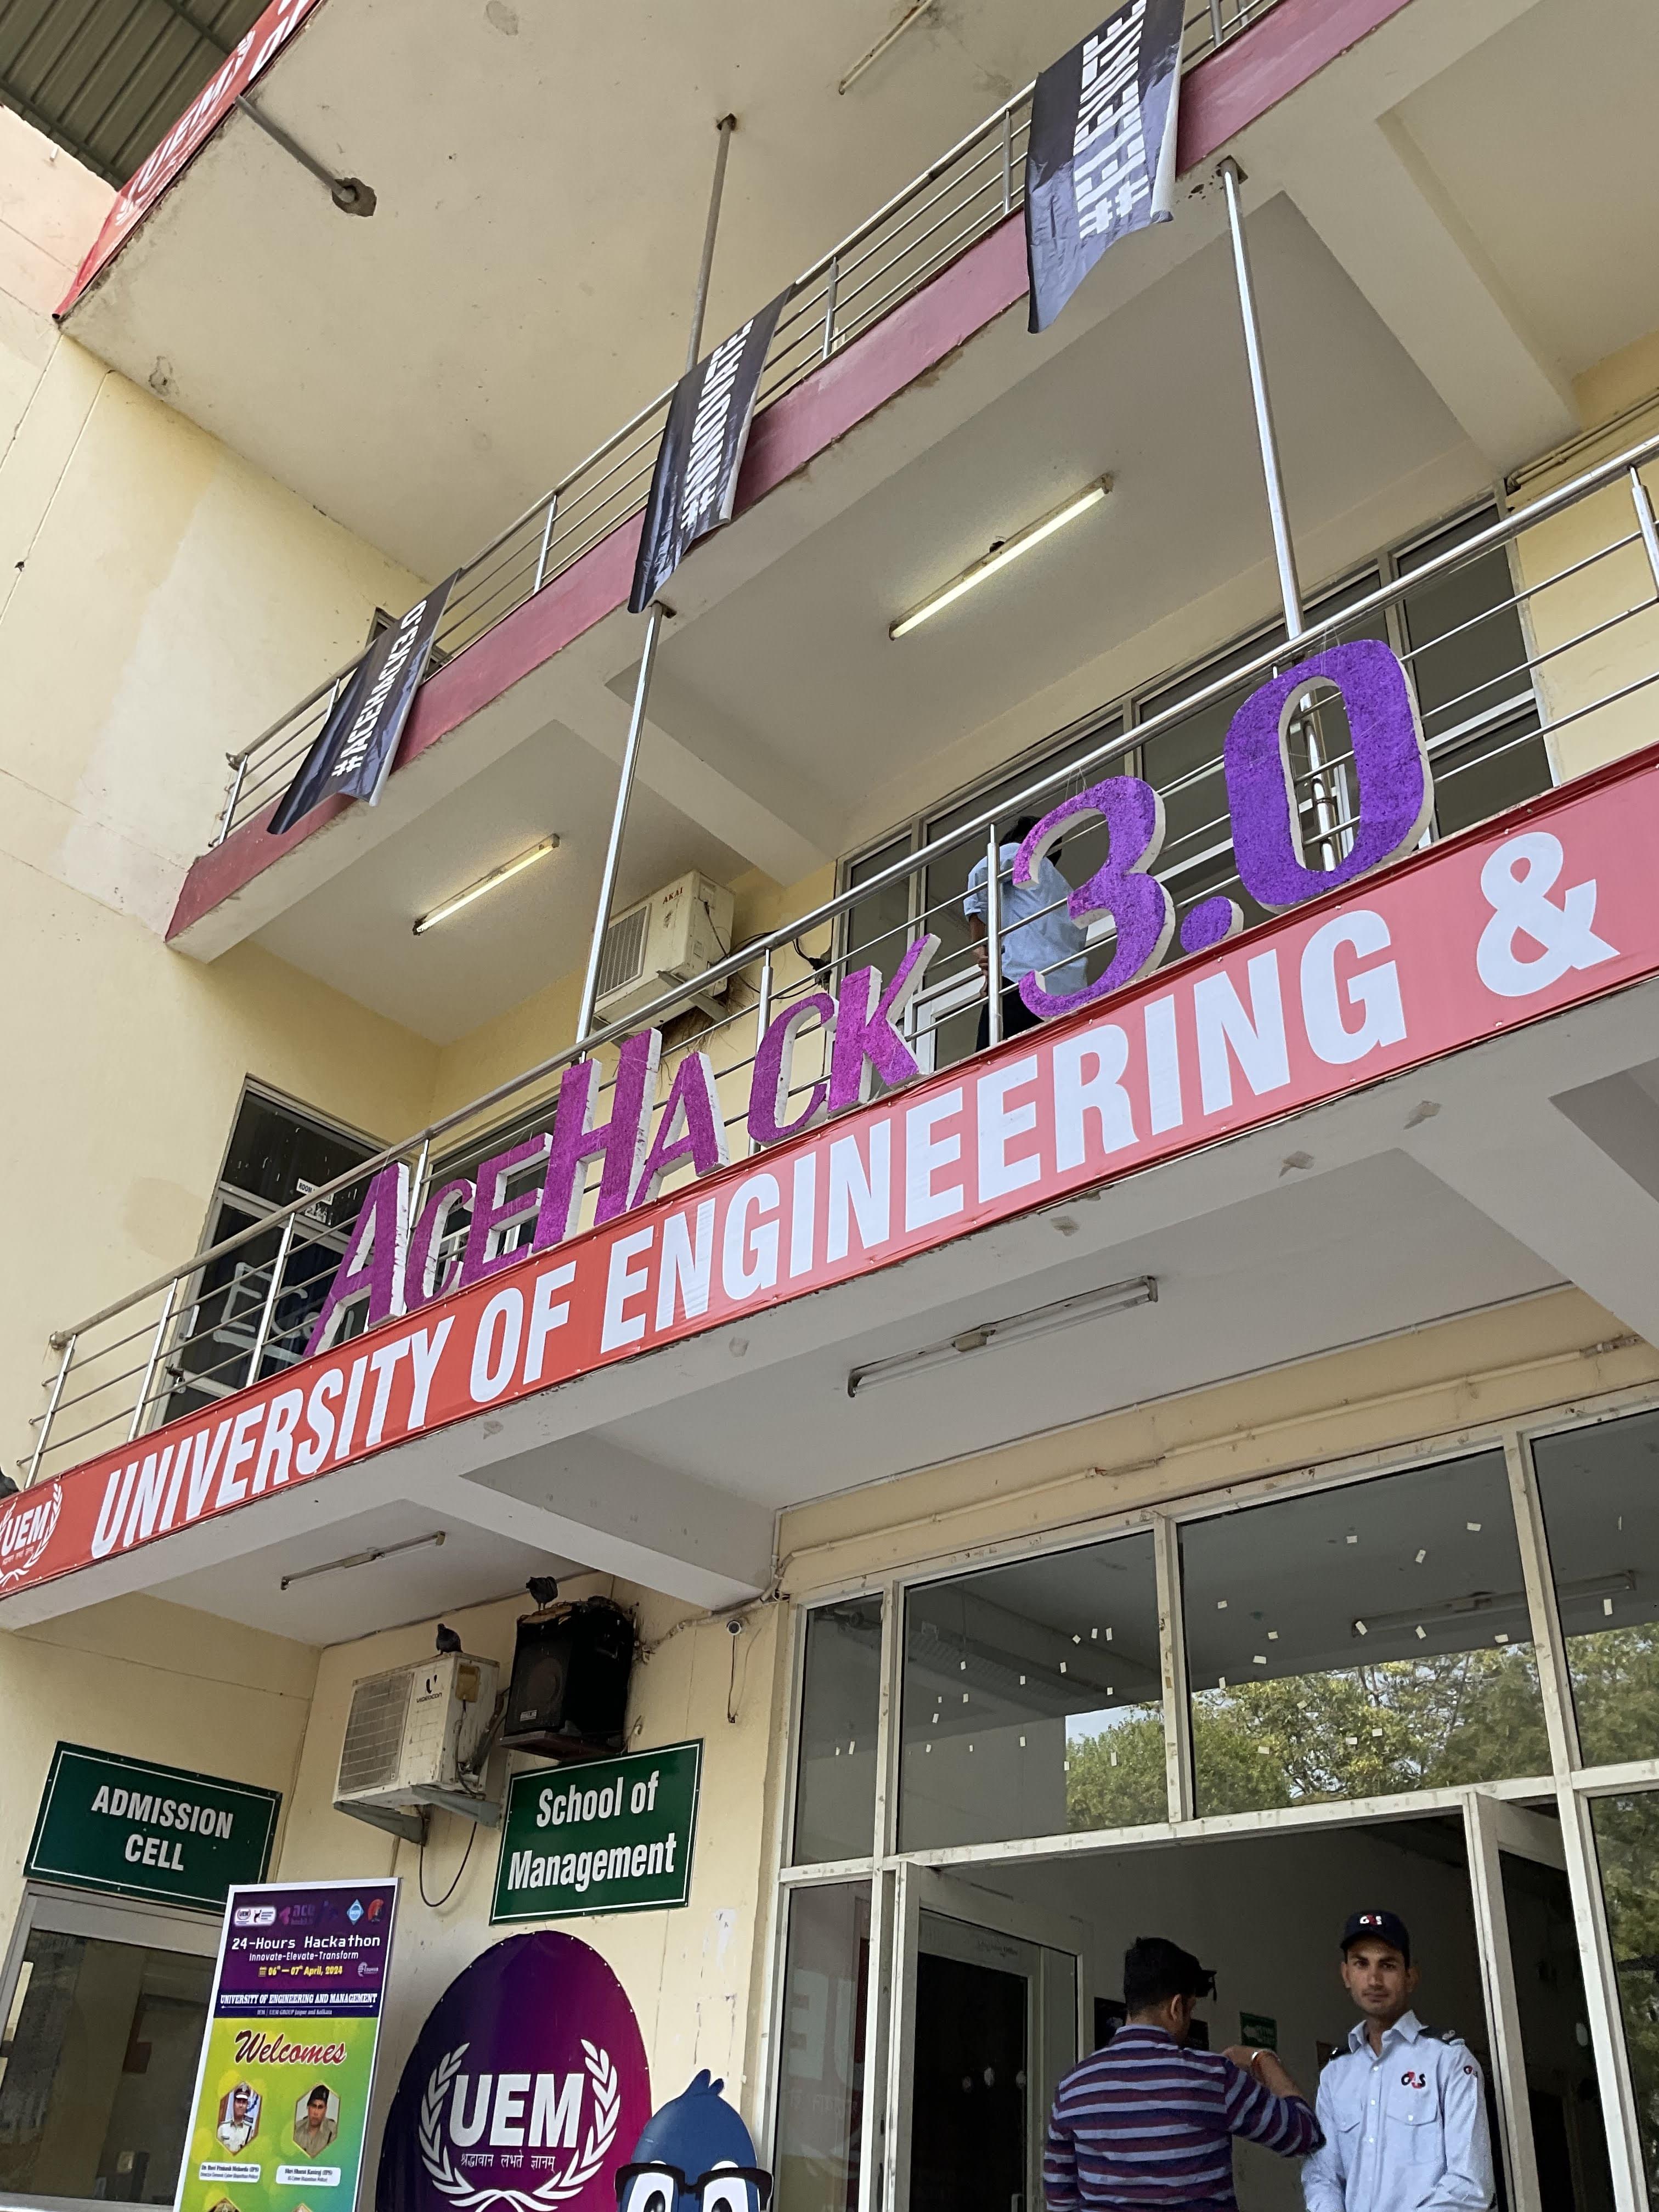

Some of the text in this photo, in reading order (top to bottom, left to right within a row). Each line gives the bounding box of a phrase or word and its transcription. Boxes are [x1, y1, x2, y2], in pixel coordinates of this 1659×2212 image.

[1073, 0, 1149, 240] #ELEVATE
[680, 319, 754, 529] #INNOVATE
[331, 600, 427, 777] #ACEHACK3.0
[1012, 639, 1434, 1019] 3.0
[663, 887, 684, 904] AKAI
[91, 831, 1621, 1559] UNIVERSITY OF ENGINEERING &
[298, 1182, 313, 1193] ROOM
[2, 1500, 53, 1556] UEM
[91, 1785, 234, 1839] ADMISSION
[537, 1770, 659, 1827] School of
[125, 1834, 184, 1871] CELL
[507, 1832, 676, 1893] Management
[232, 1934, 380, 1950] 24-Hours Hackathon
[250, 1950, 358, 1961] Innovate-Elevate-Transform
[220, 1993, 377, 2004] UNIVERSITY OF ENGINEERING AND MANAGEMENT
[303, 1966, 323, 1977] April,
[325, 1966, 343, 1975] 2024
[235, 2029, 346, 2065] Welcomes
[449, 2073, 585, 2148] UEM
